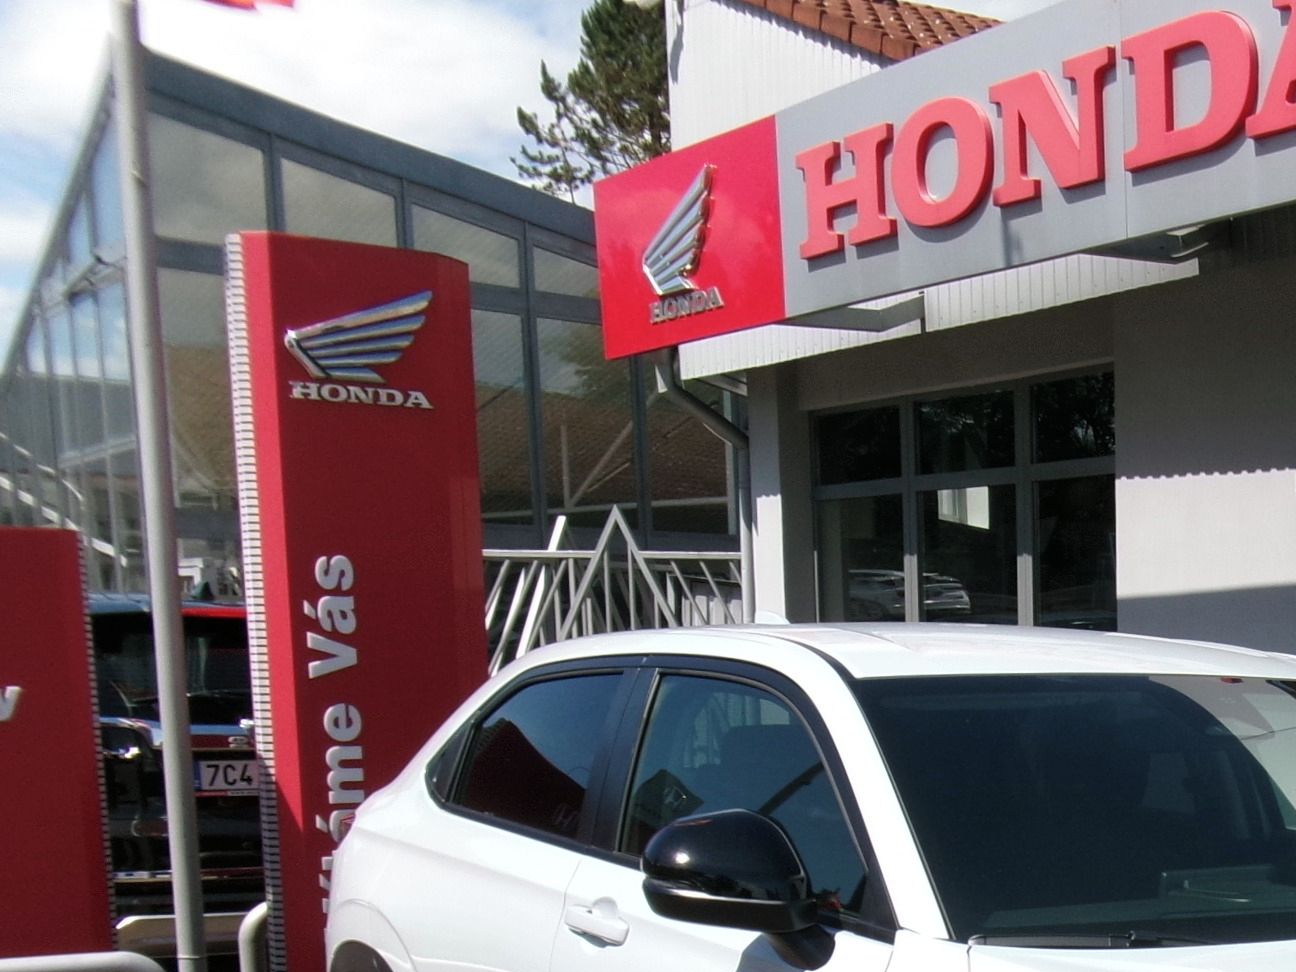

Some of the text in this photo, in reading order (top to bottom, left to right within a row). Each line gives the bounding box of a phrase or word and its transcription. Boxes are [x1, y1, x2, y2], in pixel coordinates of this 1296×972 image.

[649, 286, 724, 324] HONDA
[289, 381, 434, 409] HONDA
[304, 555, 358, 679] Vás
[206, 764, 253, 787] 7C4
